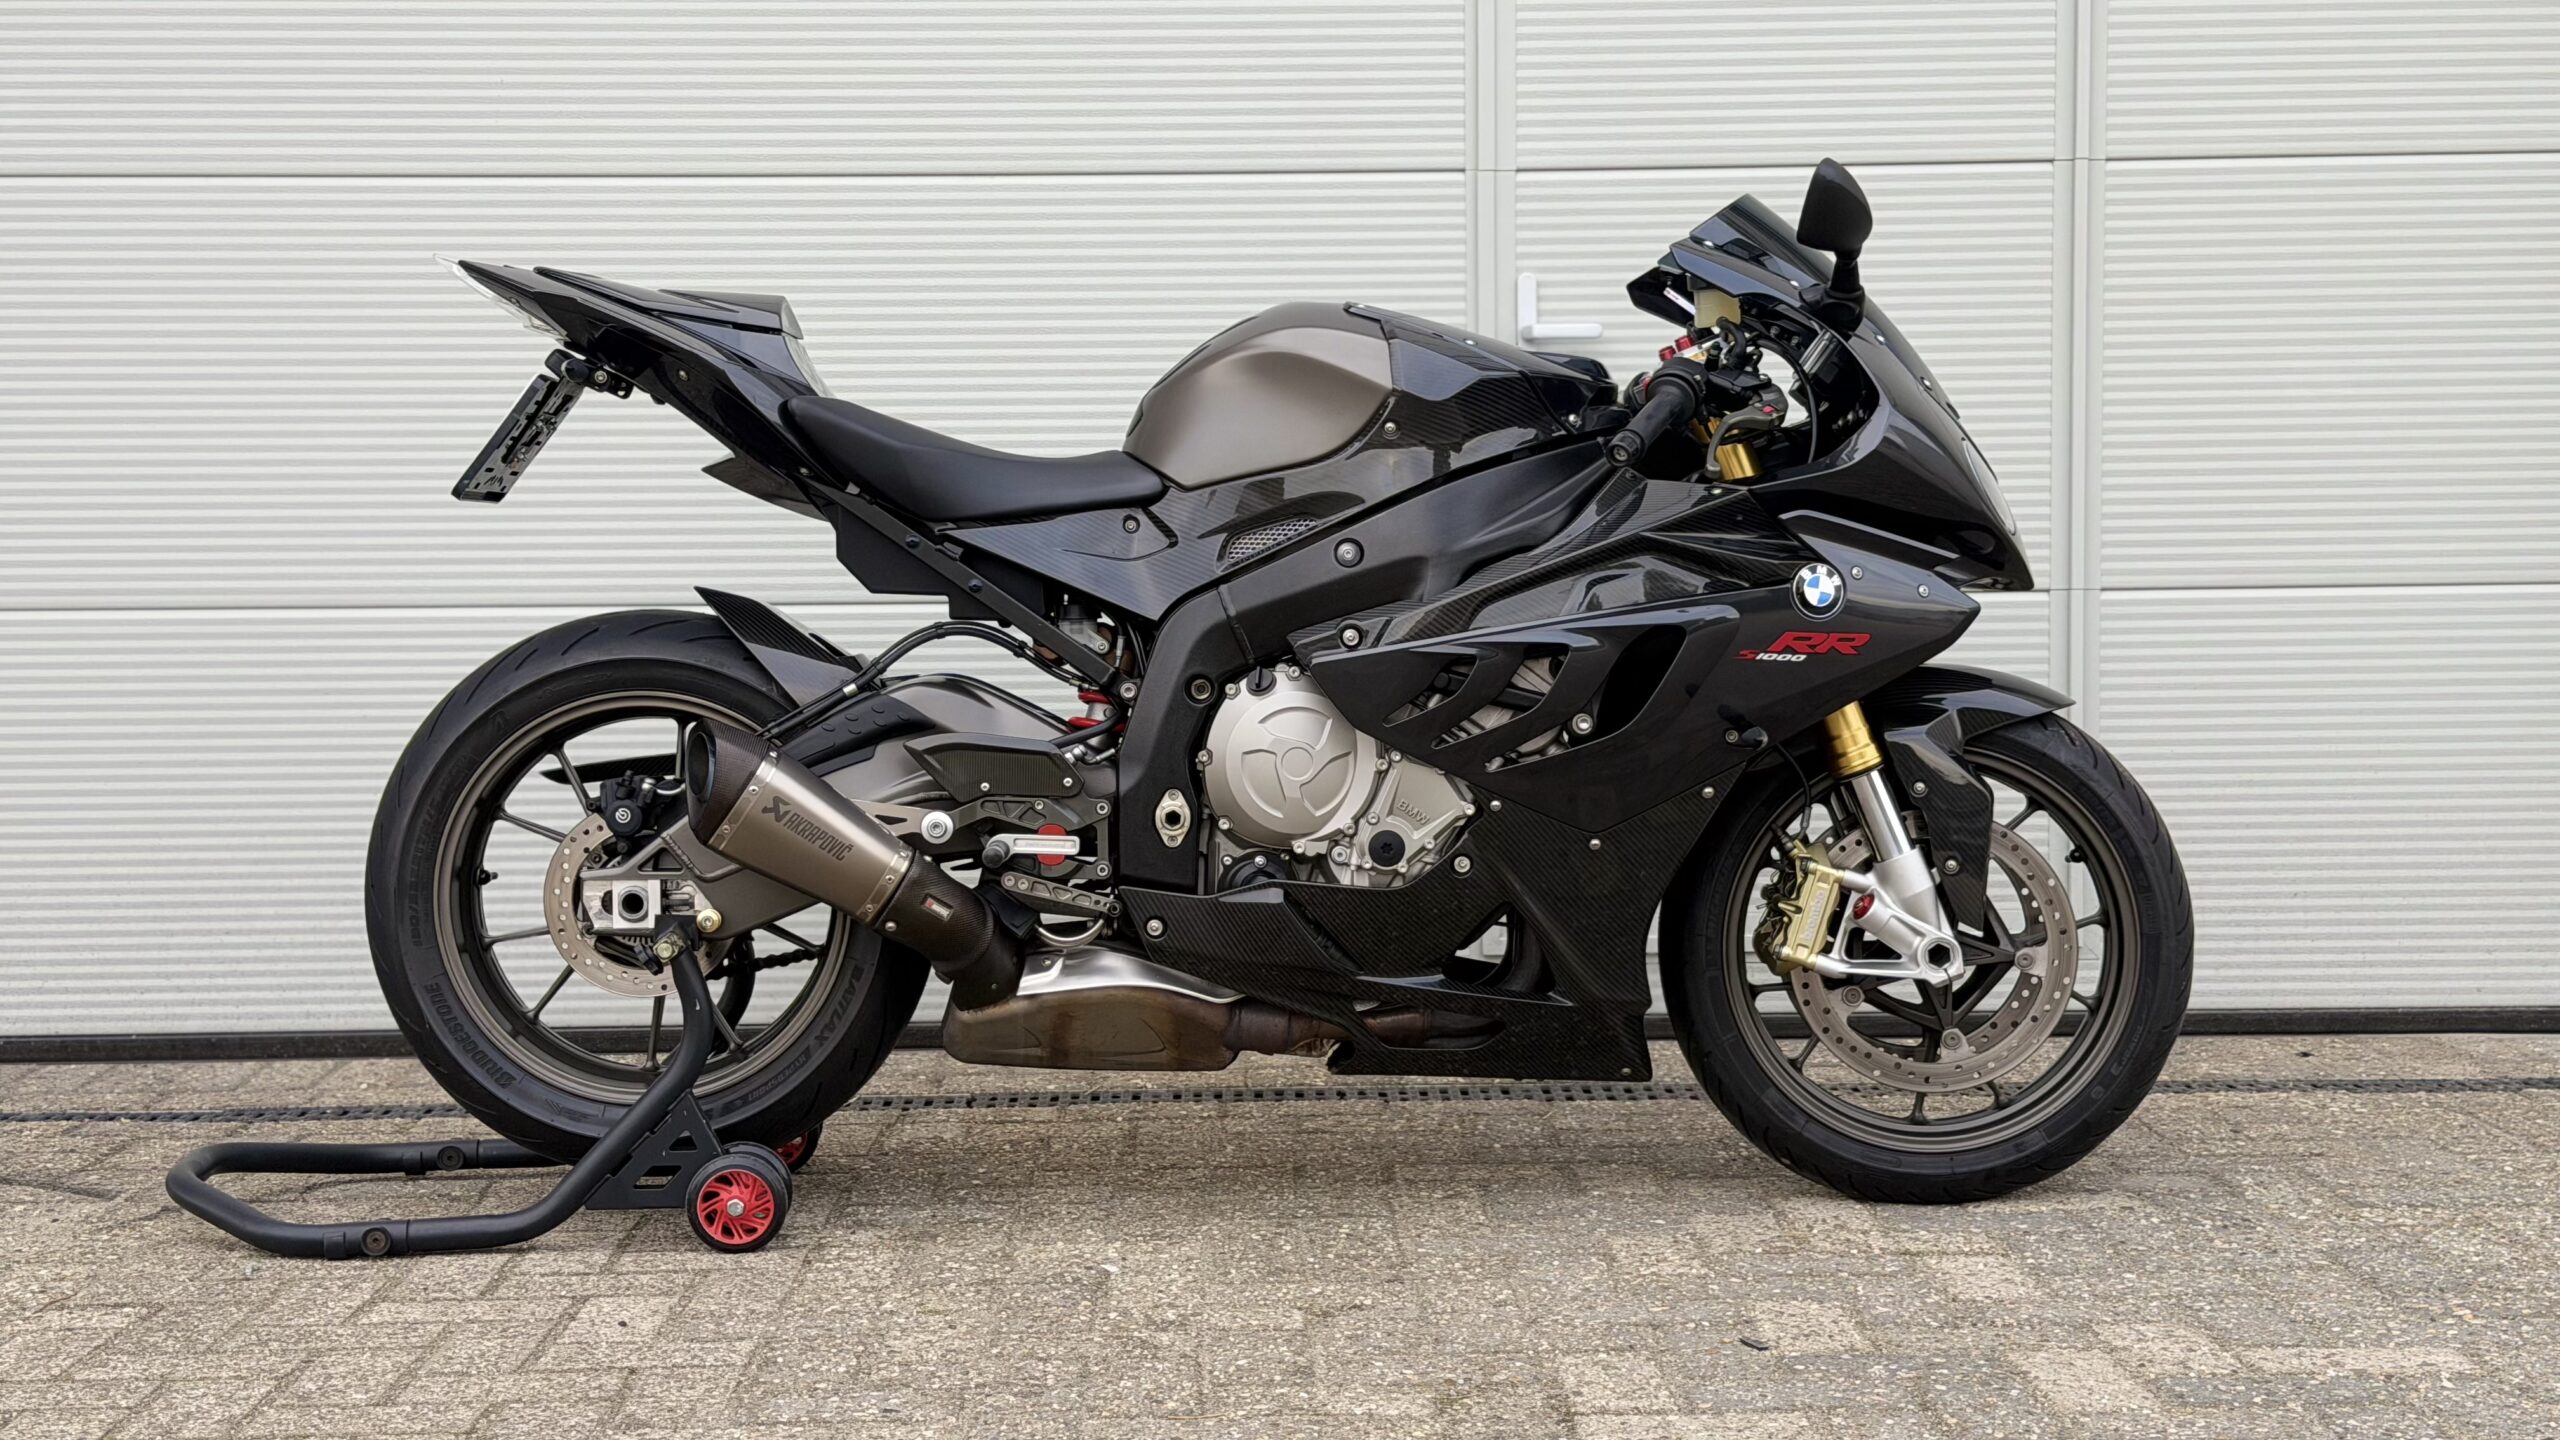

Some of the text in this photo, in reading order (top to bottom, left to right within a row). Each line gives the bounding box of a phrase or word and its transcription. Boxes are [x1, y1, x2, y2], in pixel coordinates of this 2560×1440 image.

[1799, 564, 1842, 586] BMW
[1734, 631, 1871, 662] S1000 RR
[1397, 799, 1431, 825] BMW
[424, 981, 518, 1090] BRIDGESTONE
